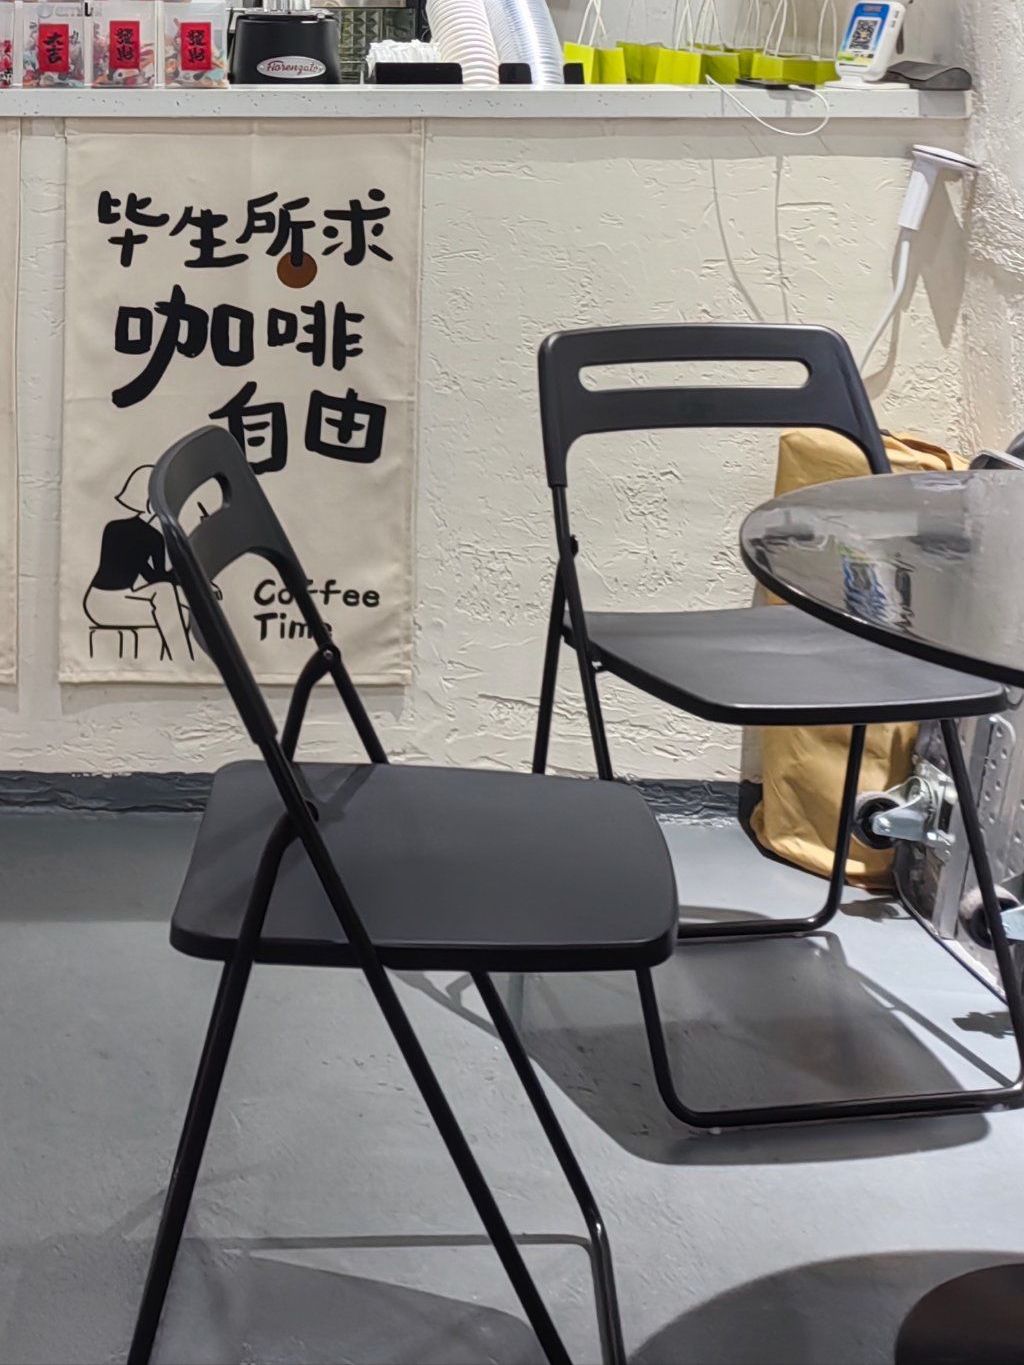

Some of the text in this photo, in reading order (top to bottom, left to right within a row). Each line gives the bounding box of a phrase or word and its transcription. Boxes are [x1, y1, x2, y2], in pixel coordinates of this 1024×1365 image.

[44, 32, 65, 64] 大吉
[266, 60, 318, 75] Fiorenzato
[97, 188, 394, 268] 毕生所求
[111, 284, 365, 409] 咖啡
[208, 381, 387, 475] 自由
